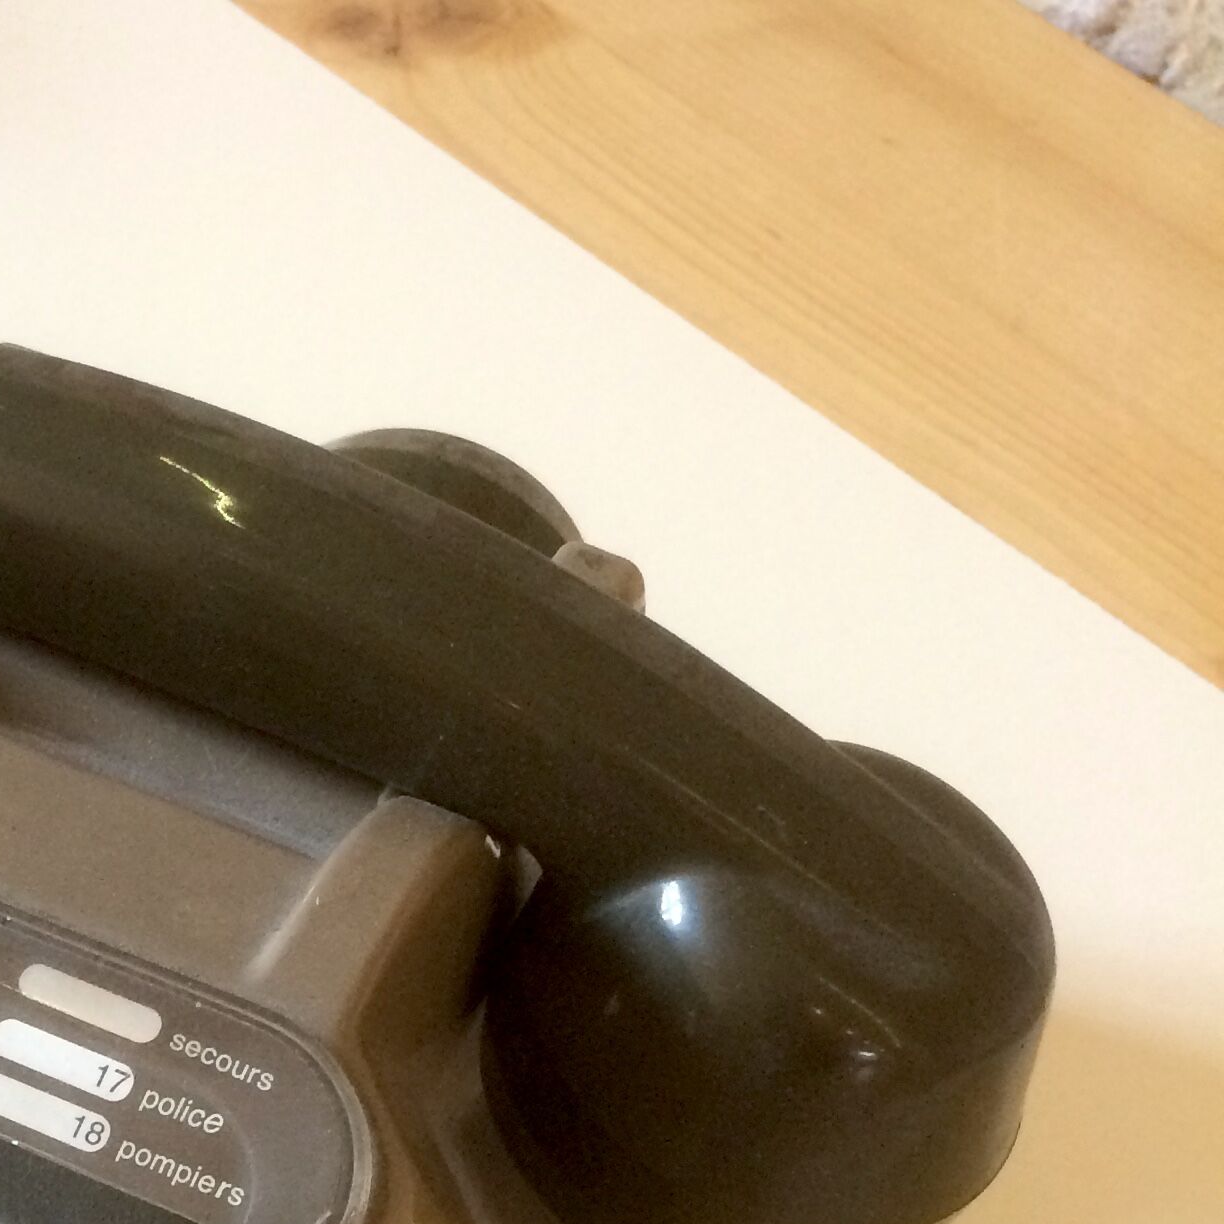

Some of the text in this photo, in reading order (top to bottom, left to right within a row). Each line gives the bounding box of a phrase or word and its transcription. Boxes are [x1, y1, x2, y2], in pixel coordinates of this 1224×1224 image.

[169, 1032, 275, 1091] secours
[94, 1063, 225, 1133] 17 police
[71, 1115, 247, 1207] 18 pompiers
